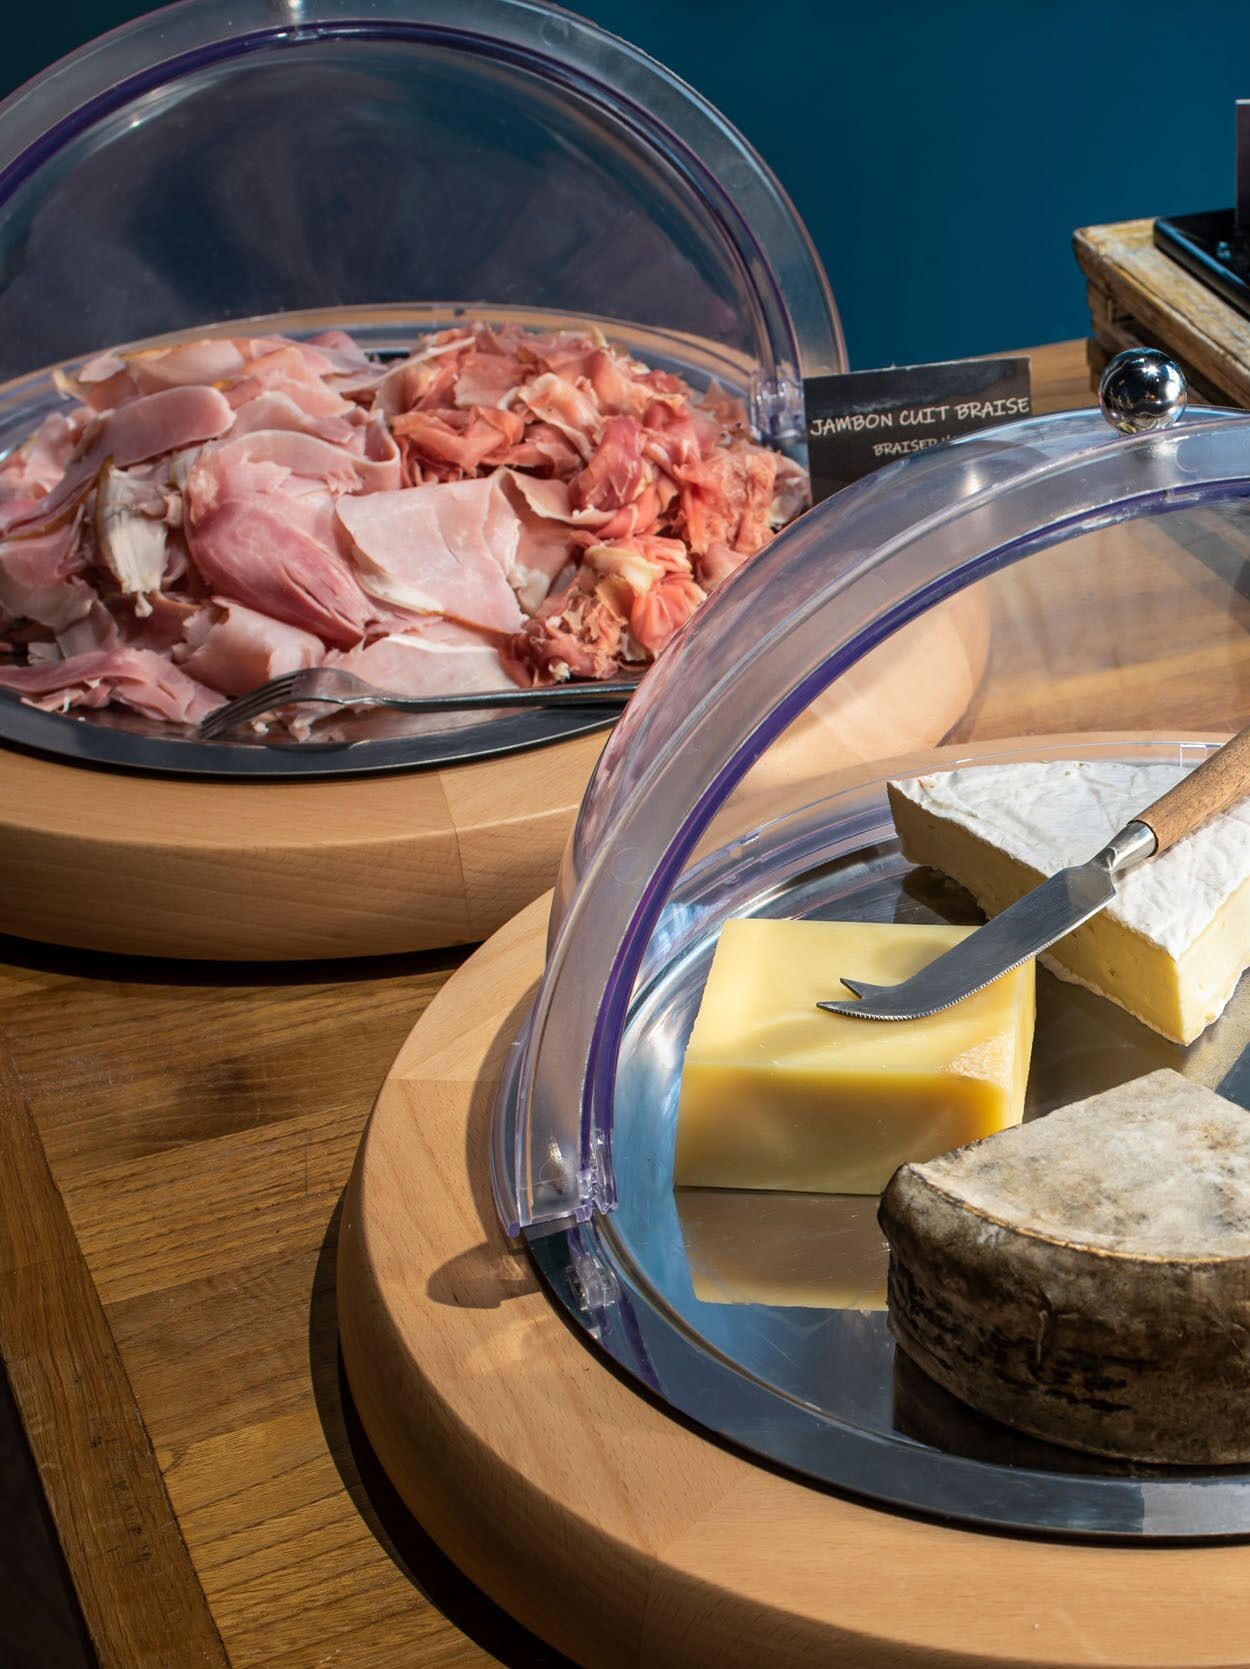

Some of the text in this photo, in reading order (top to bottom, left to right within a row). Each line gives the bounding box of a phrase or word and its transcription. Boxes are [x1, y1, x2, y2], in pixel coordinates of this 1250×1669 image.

[810, 397, 1030, 436] JAMBON CUIT BRAISE
